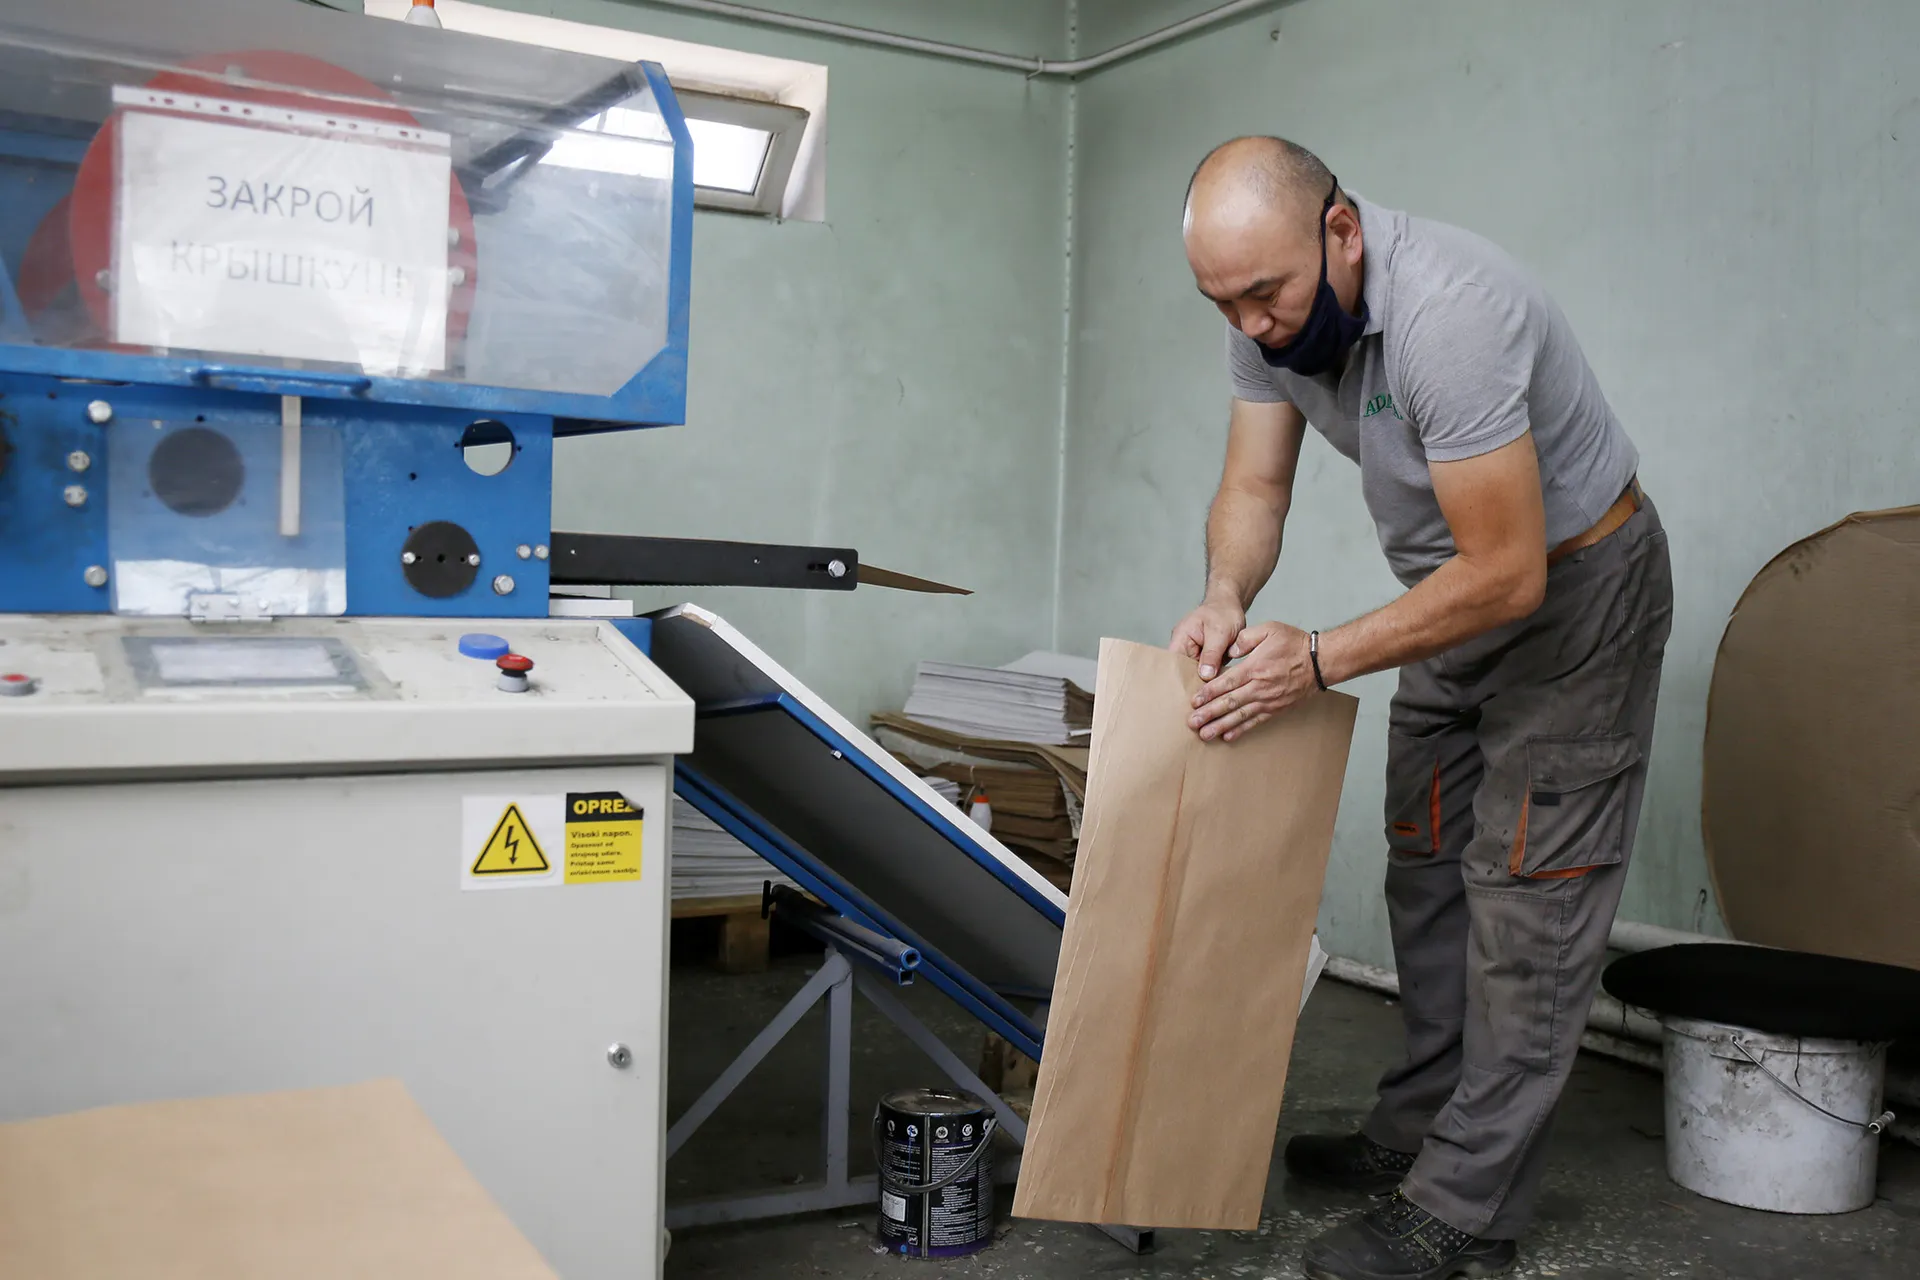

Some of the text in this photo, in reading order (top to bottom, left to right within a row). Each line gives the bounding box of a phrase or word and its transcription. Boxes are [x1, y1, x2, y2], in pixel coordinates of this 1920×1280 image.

[206, 175, 374, 227] ЗАКРОЙ
[570, 830, 633, 839] Visoki napon.
